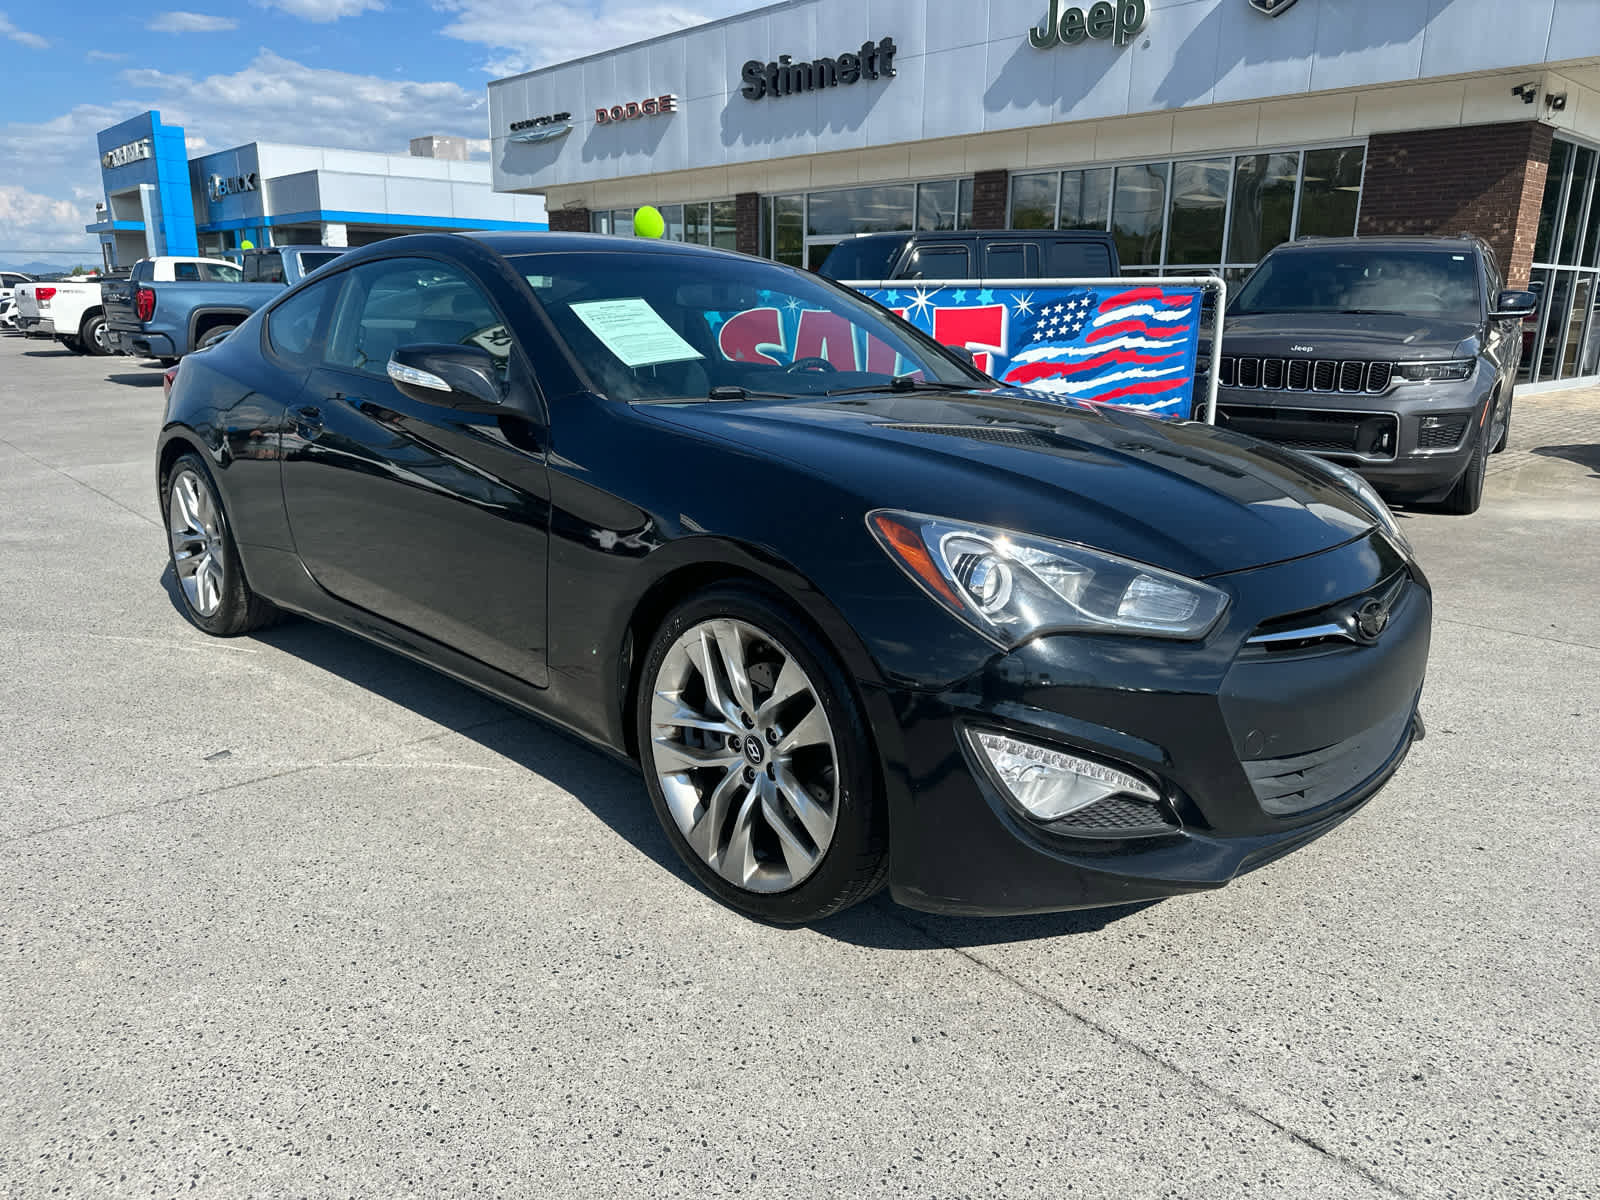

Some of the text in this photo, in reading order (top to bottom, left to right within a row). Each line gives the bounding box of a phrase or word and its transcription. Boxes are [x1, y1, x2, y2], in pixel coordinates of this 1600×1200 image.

[1028, 0, 1147, 48] Jeep
[741, 37, 897, 100] Stinnett
[595, 94, 678, 124] DODGE
[1290, 344, 1314, 353] Jeep
